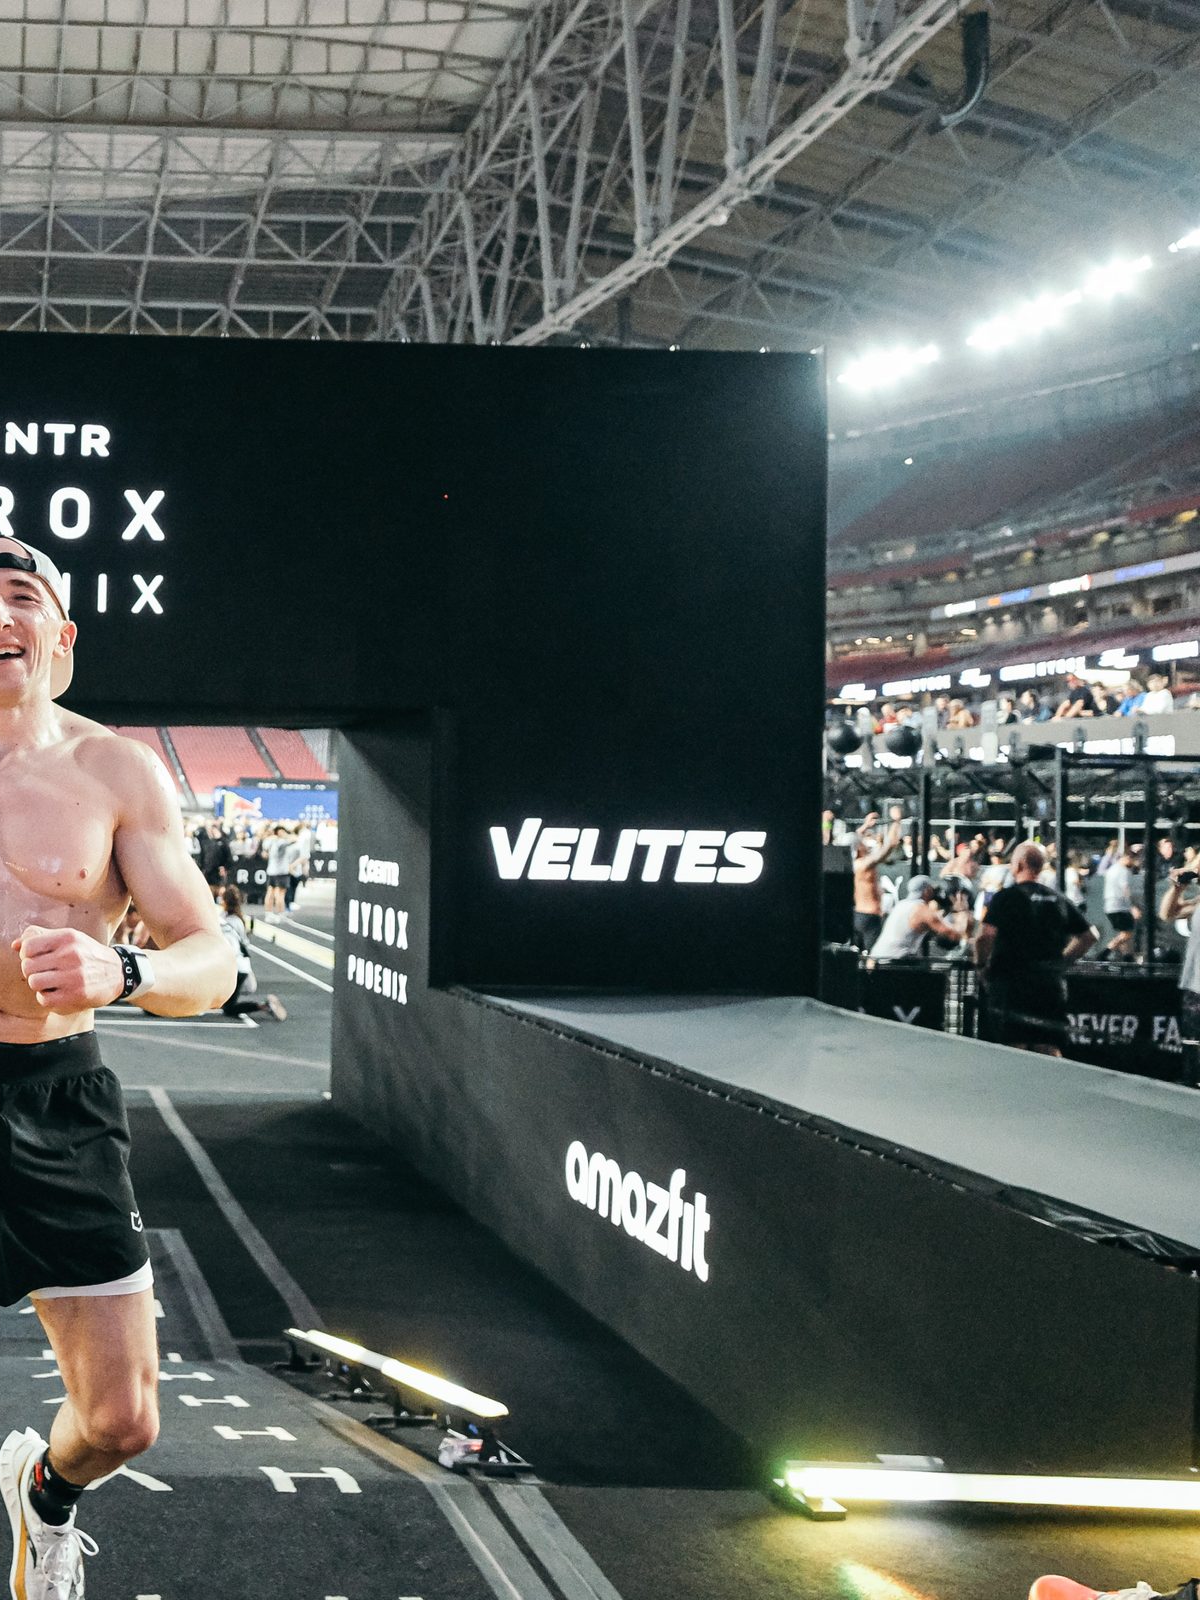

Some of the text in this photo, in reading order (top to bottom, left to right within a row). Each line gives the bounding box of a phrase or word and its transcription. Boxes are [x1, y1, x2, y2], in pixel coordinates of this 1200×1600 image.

[488, 817, 768, 886] VELITES
[348, 898, 409, 951] HYROX
[347, 954, 408, 1005] PHOENIX
[564, 1140, 711, 1283] amazfit
